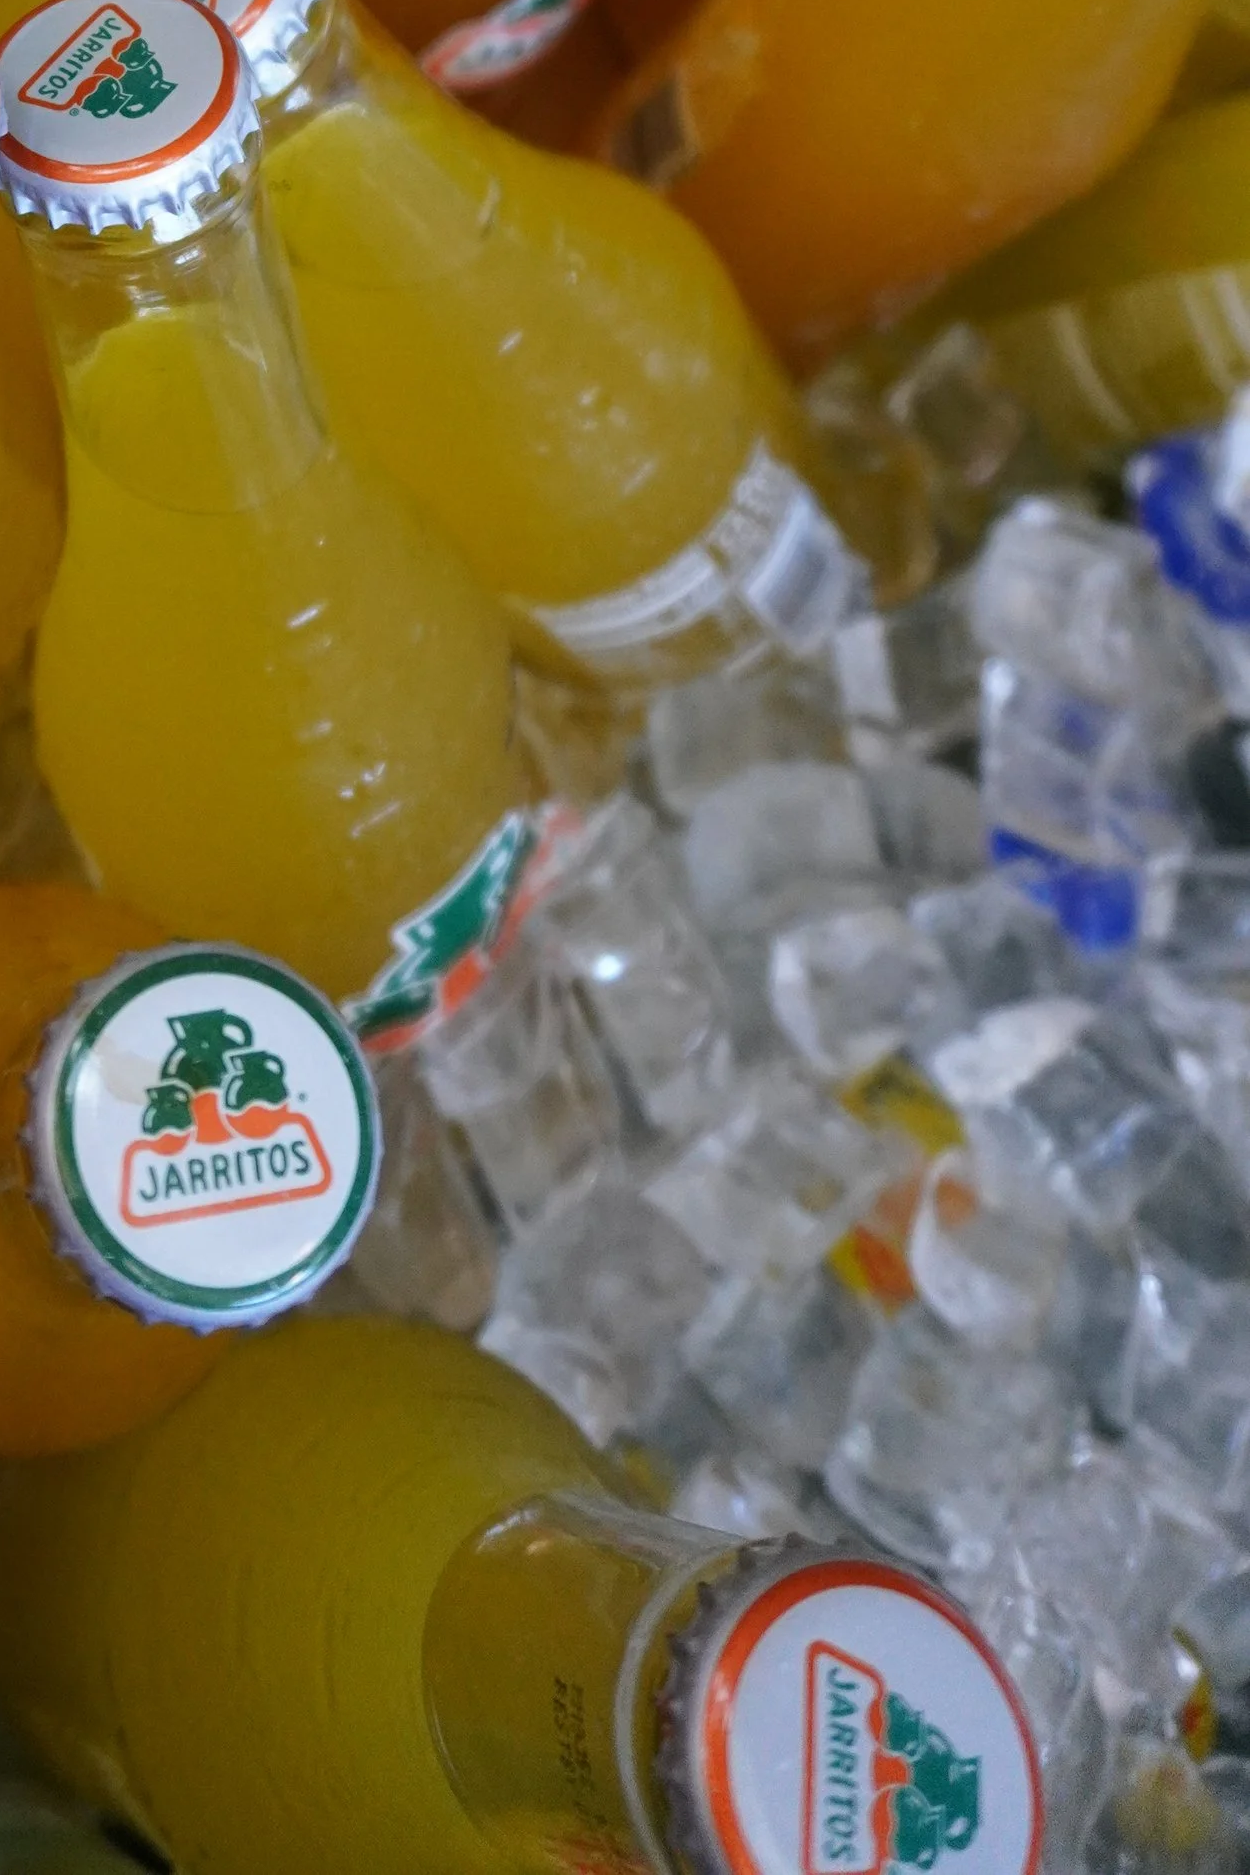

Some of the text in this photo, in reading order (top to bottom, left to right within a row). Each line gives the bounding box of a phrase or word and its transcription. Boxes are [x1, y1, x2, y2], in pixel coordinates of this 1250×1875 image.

[38, 17, 122, 99] JARRITOS
[139, 1140, 312, 1203] JARRITOS
[822, 1666, 861, 1862] JARRITOS
